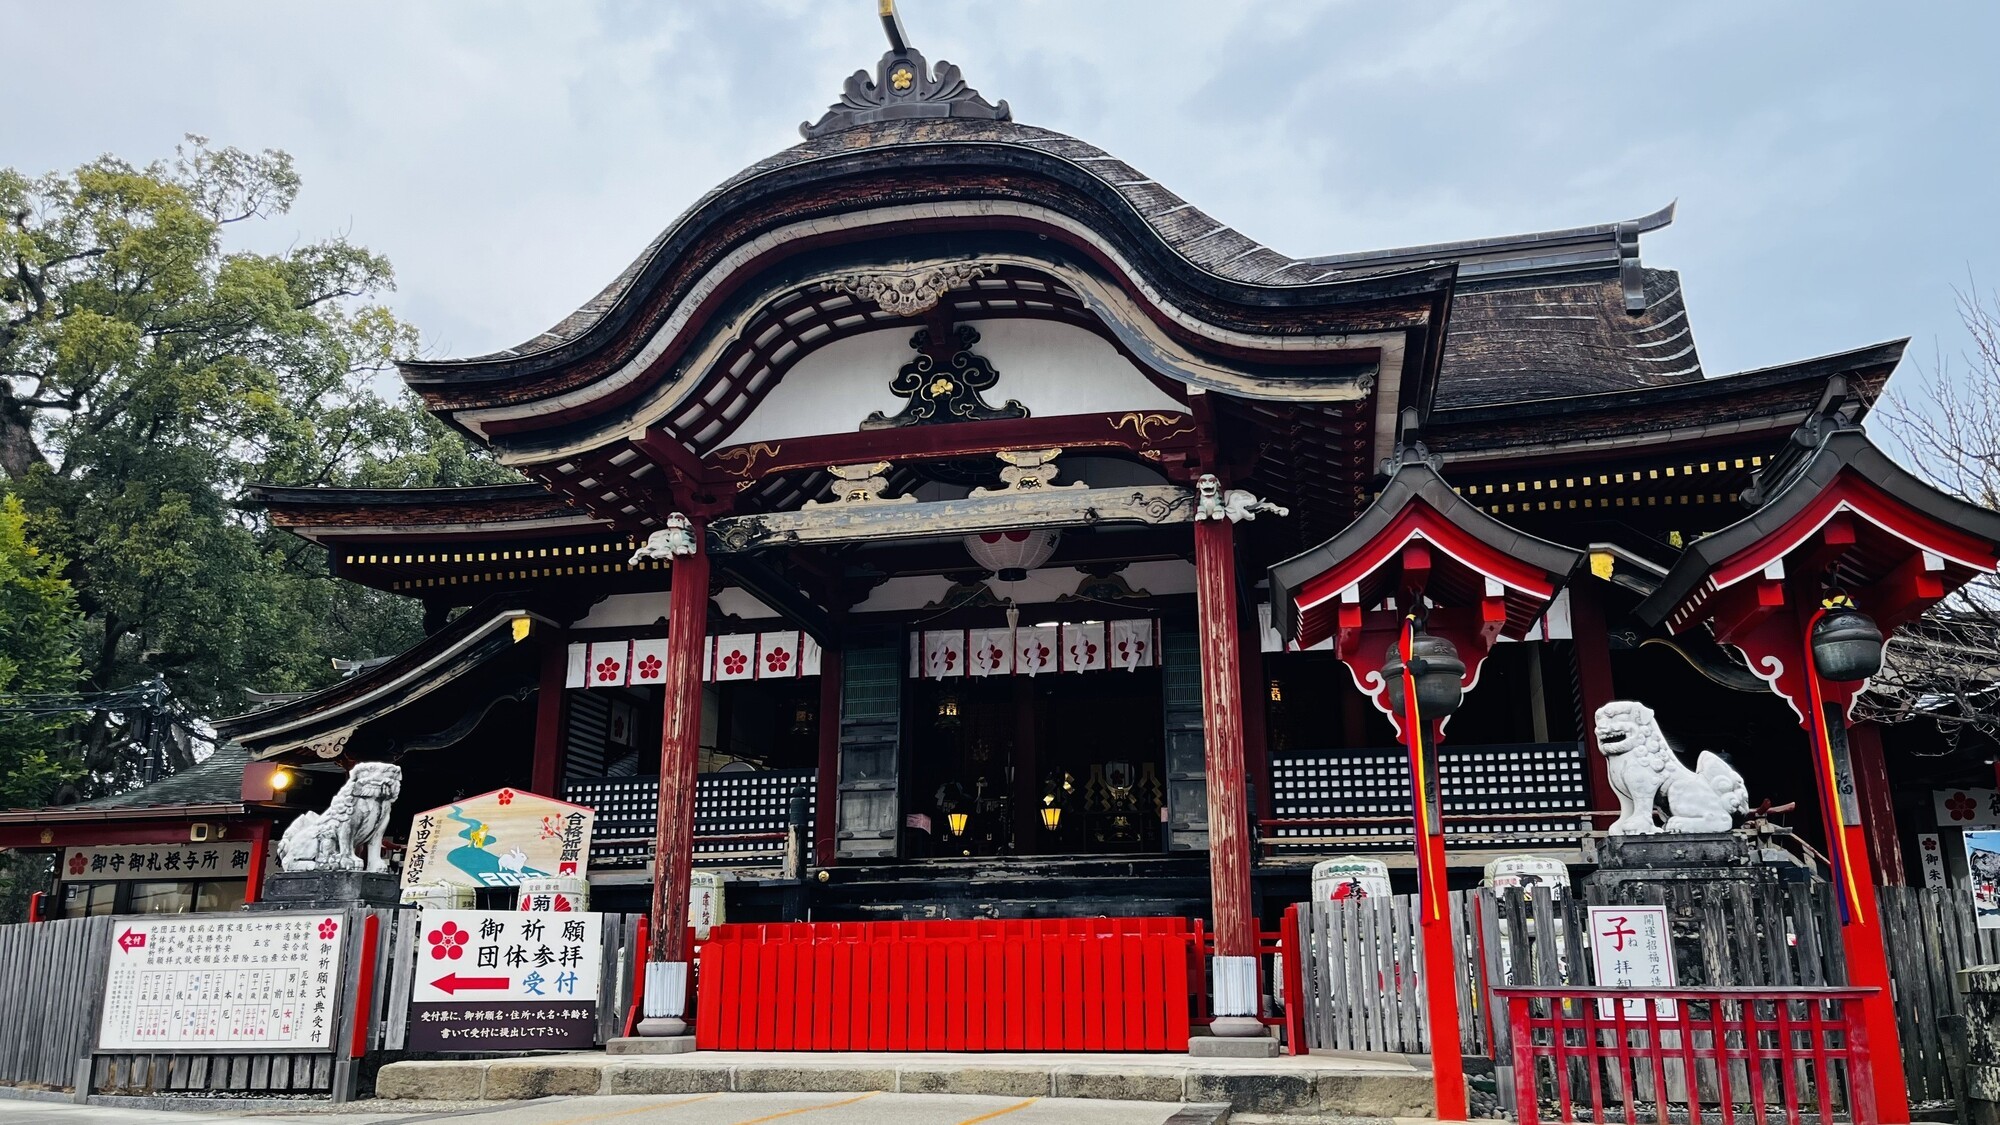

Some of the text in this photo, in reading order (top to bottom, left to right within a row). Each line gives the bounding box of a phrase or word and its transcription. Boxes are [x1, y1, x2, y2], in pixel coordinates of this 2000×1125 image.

[407, 815, 434, 884] 水田天満宮
[560, 811, 587, 861] 合格祈願
[91, 850, 219, 873] 御守御札授与所
[532, 895, 551, 912] 菊
[124, 935, 142, 945] 受付
[204, 925, 215, 963] 必勝祈願
[213, 924, 224, 963] 商売繁盛
[223, 923, 234, 963] 家内安全
[242, 924, 253, 962] 厄除
[251, 924, 263, 963] 七五三
[261, 923, 273, 963] 初宮詣
[271, 922, 282, 962] 安産
[281, 922, 292, 961] 交通安全
[291, 921, 302, 961] 受験合格
[301, 921, 312, 961] 学業成就
[478, 918, 586, 942] 御祈願
[1602, 916, 1636, 952] 子
[1628, 938, 1638, 947] ね
[156, 925, 168, 965] 団体祈願
[165, 925, 177, 964] 正式参拝
[477, 945, 584, 969] 団体参拝
[202, 974, 211, 1000] 四十二歳
[213, 973, 222, 1000] 二十五歳
[237, 973, 245, 999] 六十歳
[250, 972, 259, 999] 四十一歳
[263, 973, 271, 999] 二十四歳
[287, 973, 296, 998] 男性
[299, 970, 309, 998] 厄年表
[310, 943, 332, 1043] 御祈願式典受付
[522, 970, 579, 995] 受付
[174, 991, 183, 1019] 後厄
[222, 990, 232, 1019] 本厄
[272, 989, 283, 1019] 前厄
[160, 1009, 169, 1036] 二十歳
[209, 1009, 217, 1036] 十九歳
[233, 1008, 241, 1035] 六十歳
[258, 1008, 267, 1035] 十八歳
[282, 1009, 292, 1034] 女性
[440, 1026, 569, 1039] 書いて受付に提出して下さい。
